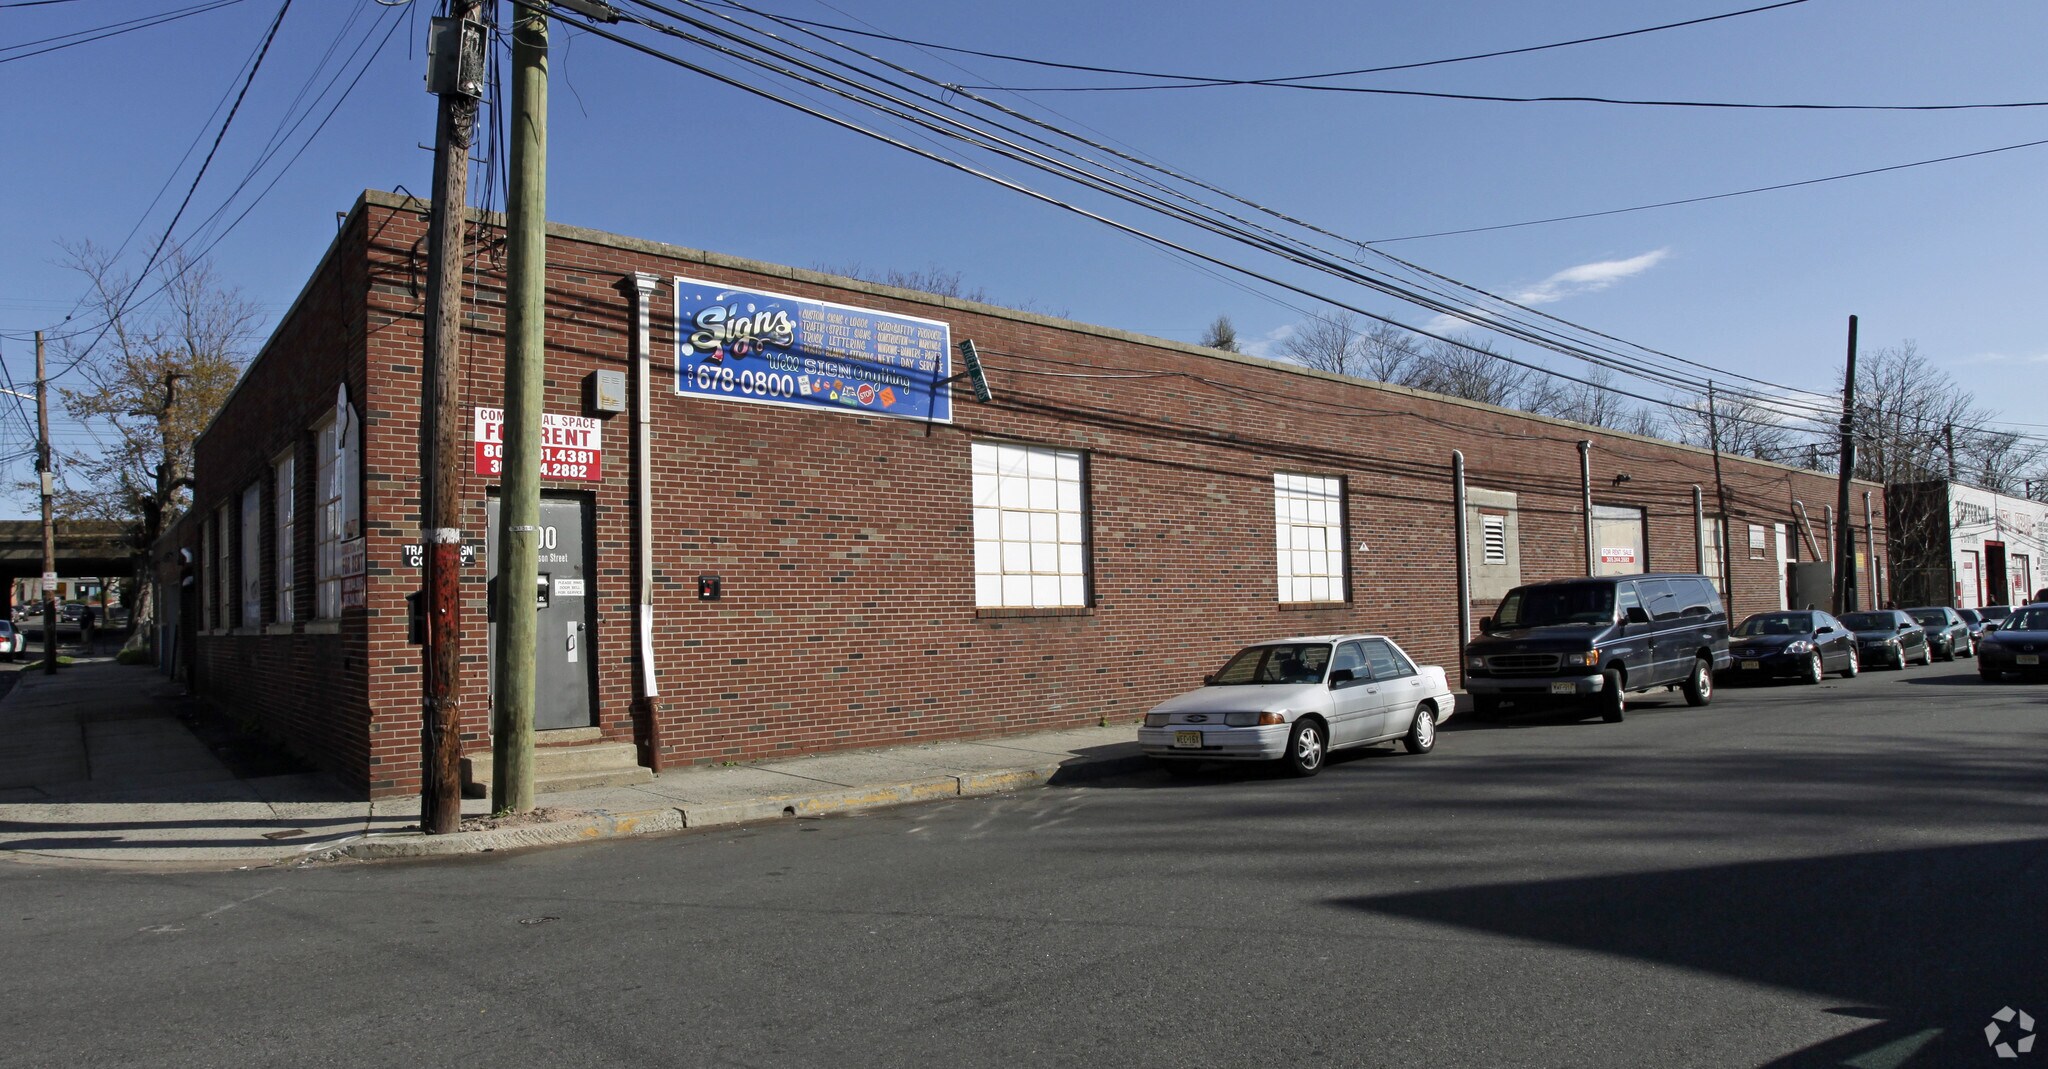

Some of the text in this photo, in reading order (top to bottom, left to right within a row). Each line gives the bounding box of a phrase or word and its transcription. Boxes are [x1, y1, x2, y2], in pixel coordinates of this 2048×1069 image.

[802, 309, 824, 321] CUSTOM
[827, 313, 844, 325] SIGNS
[850, 317, 868, 328] LOGOS
[690, 302, 794, 362] Signs
[803, 320, 825, 333] TRAFFIC
[829, 324, 850, 336] STREET
[854, 327, 872, 340] SIGNS
[803, 331, 866, 351] TRUCK LETTERING
[804, 359, 851, 379] SIGN
[878, 354, 895, 365] NEXT
[900, 357, 914, 368] DAY
[962, 342, 987, 400] STREET SIGNS
[697, 365, 794, 398] 678-0800
[860, 390, 873, 400] STOP
[562, 416, 596, 429] SPACE
[541, 428, 591, 446] RENT
[1956, 501, 1989, 524] JEFFERSON
[550, 553, 568, 563] Street
